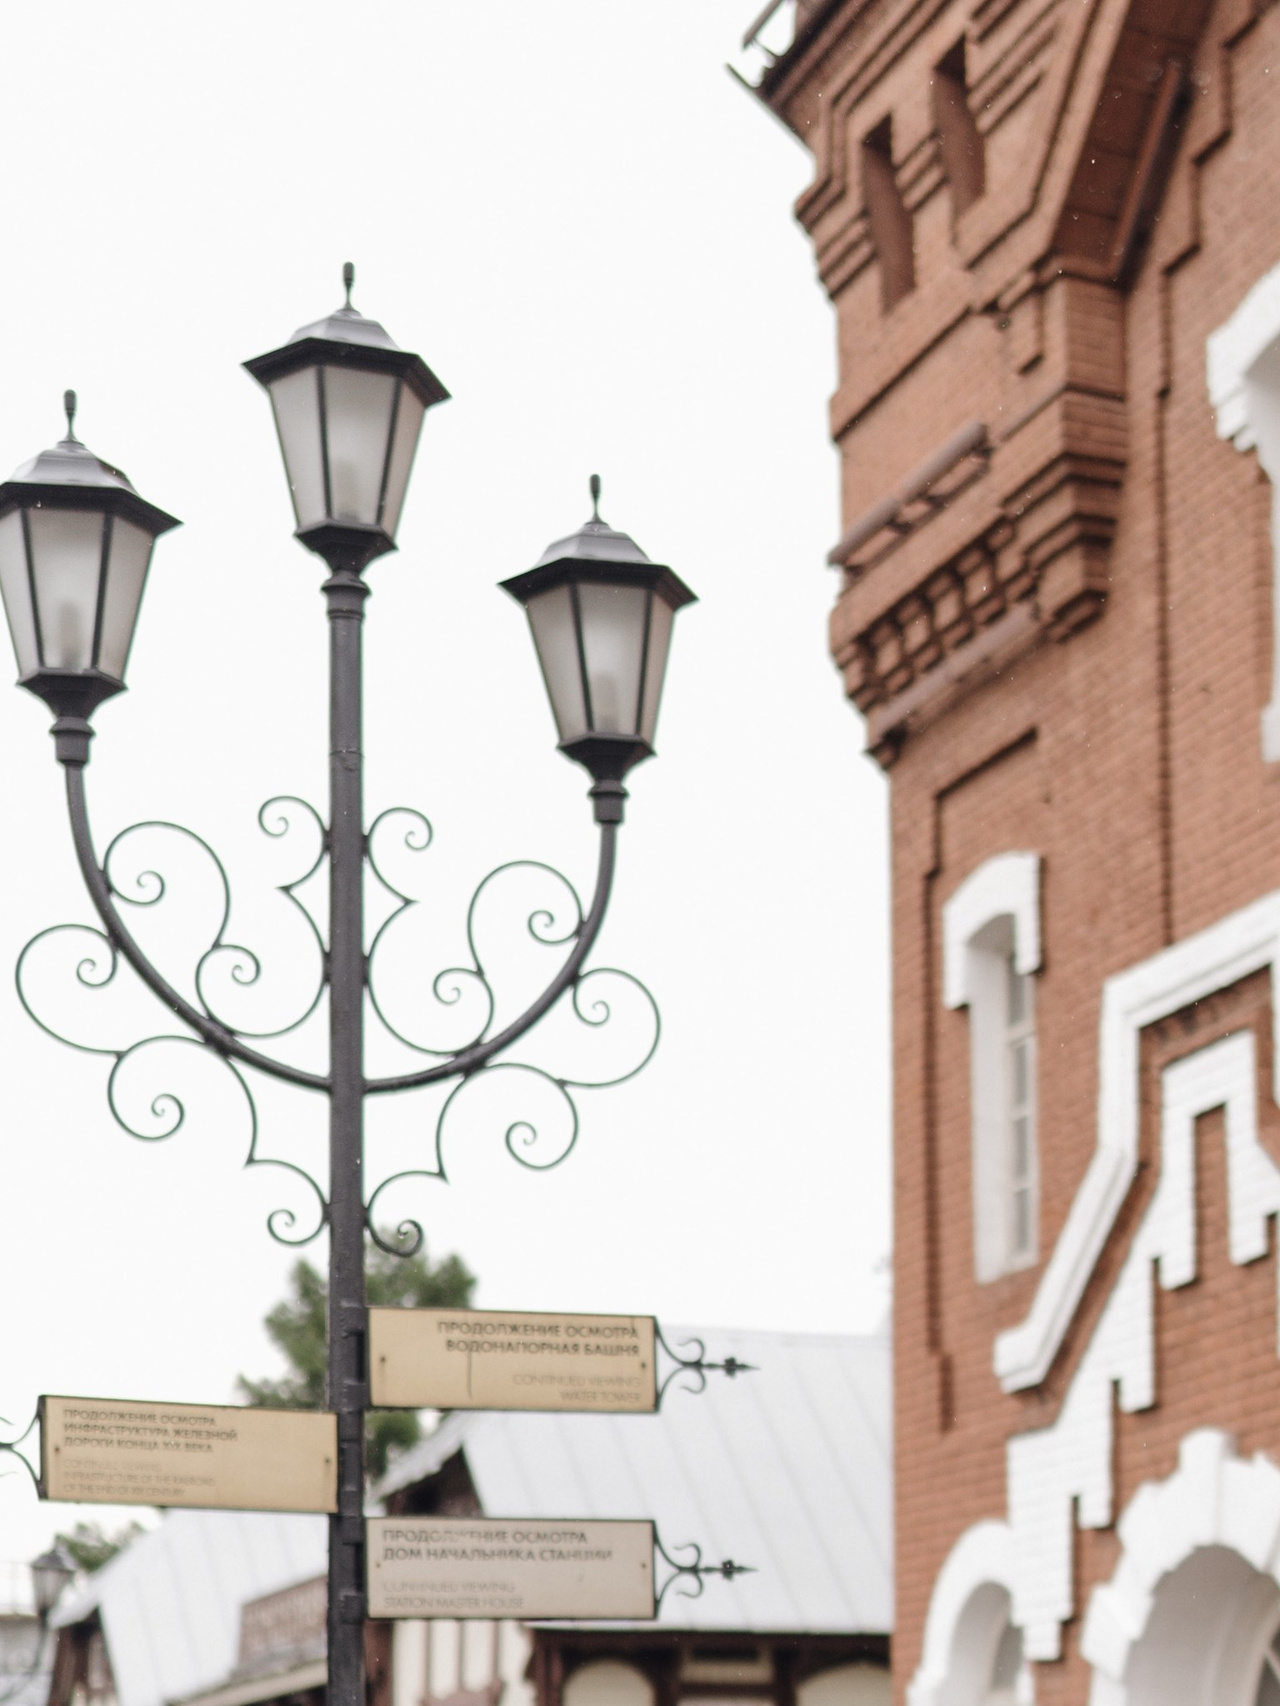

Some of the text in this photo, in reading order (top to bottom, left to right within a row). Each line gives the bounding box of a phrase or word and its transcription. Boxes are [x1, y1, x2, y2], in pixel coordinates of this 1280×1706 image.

[437, 1321, 639, 1339] ПРОДОЛЖЕНИЕ ОСМОТРА
[446, 1339, 640, 1356] ВОДОНАПОРНАЯ БАШНЯ
[64, 1409, 217, 1426] ПРОДОЛЖЕНИЕ ОСМОТРА
[64, 1423, 238, 1442] ИНФРАСТРУКТУРА ЖЕЛЕЗНОЙ
[64, 1436, 115, 1448] ДОРОГИ
[117, 1439, 159, 1451] КОНЦА
[185, 1442, 213, 1453] ВЕКА
[512, 1530, 588, 1544] ОСМОТРА
[383, 1548, 613, 1562] ДОМ НАЧАЛЬНИКА СТАНЦИИ
